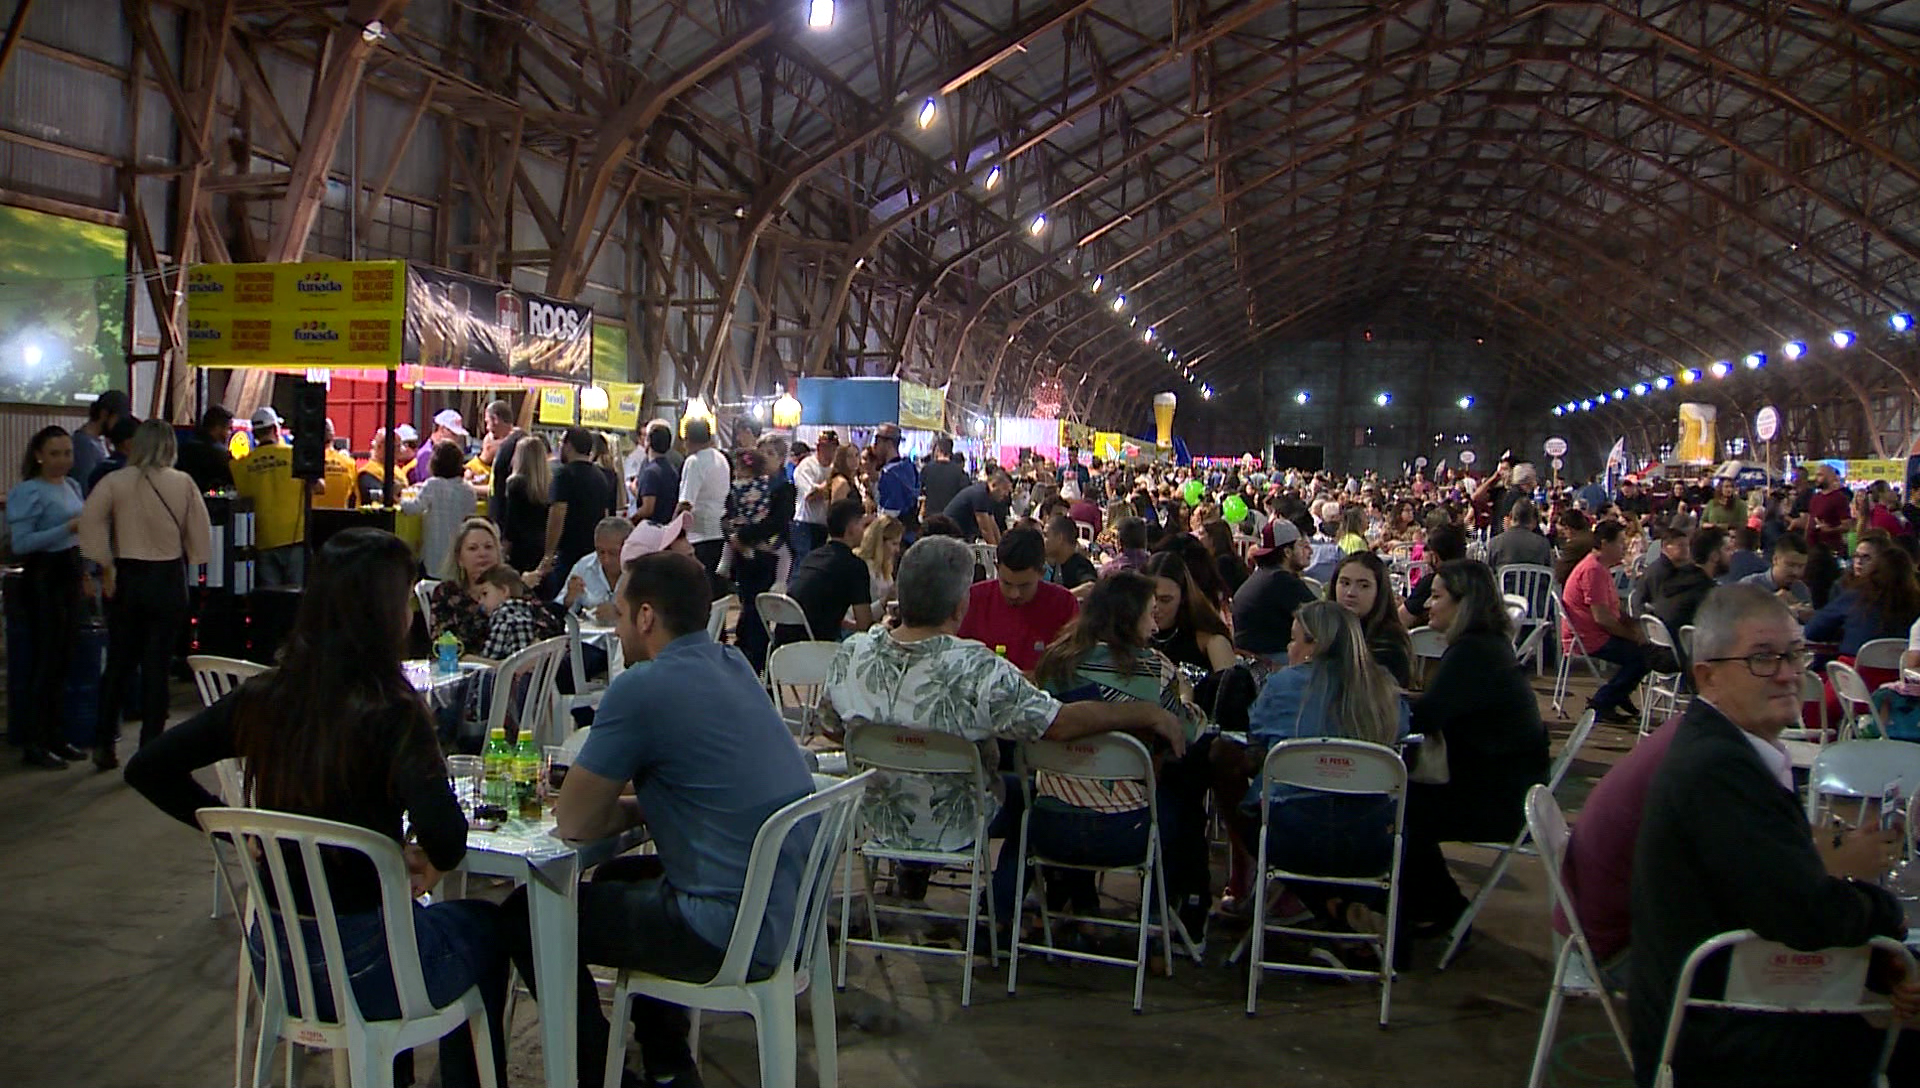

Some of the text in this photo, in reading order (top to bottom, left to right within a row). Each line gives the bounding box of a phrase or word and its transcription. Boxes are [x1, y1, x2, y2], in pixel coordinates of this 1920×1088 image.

[298, 280, 342, 292] funada
[528, 301, 580, 341] ROOS
[294, 328, 339, 340] funada
